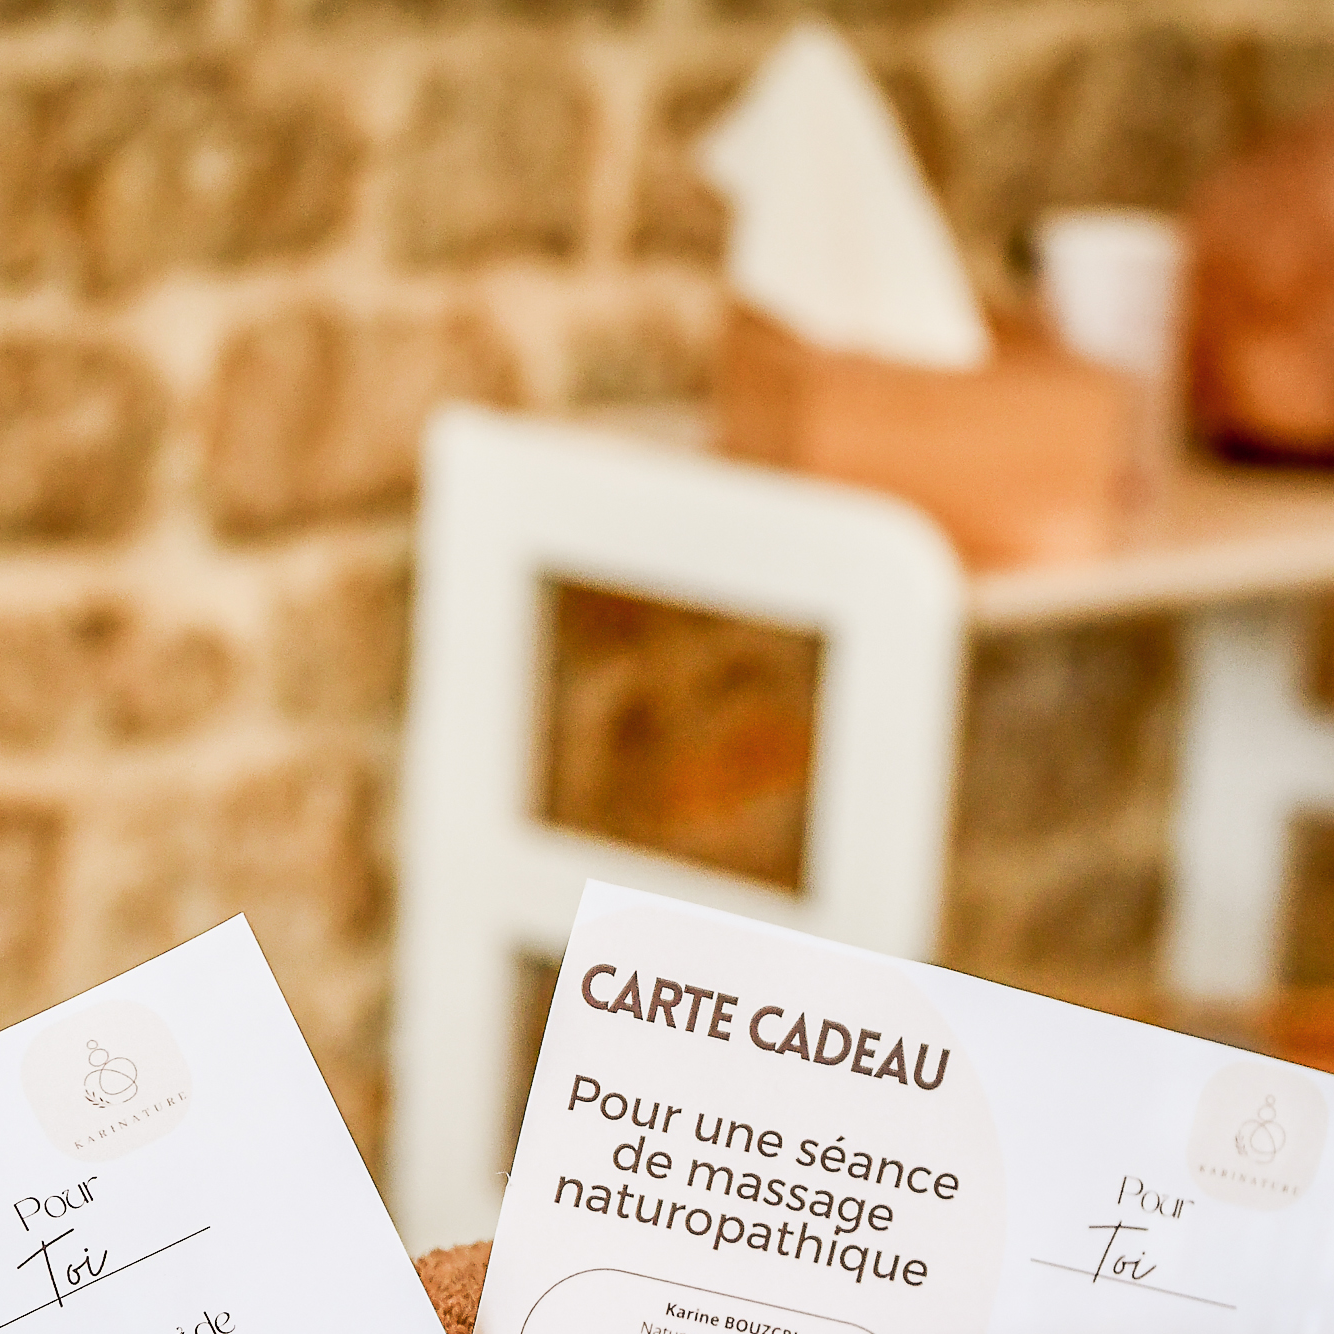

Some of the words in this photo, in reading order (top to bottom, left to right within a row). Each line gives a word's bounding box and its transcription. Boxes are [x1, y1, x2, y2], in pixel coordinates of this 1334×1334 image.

[581, 963, 739, 1041] CARTE
[749, 1005, 951, 1091] CADEAU
[74, 1091, 187, 1150] KARINATURE
[567, 1074, 682, 1134] Pour
[694, 1112, 783, 1159] une
[795, 1136, 960, 1200] séance
[13, 1176, 98, 1232] Pour
[612, 1135, 673, 1179] de
[686, 1159, 894, 1235] massage
[1118, 1175, 1195, 1219] Pour
[1199, 1163, 1299, 1196] KARINATURE
[554, 1175, 928, 1287] naturopathique
[1089, 1220, 1157, 1283] Toi
[17, 1228, 108, 1308] Toi
[666, 1302, 720, 1328] Karine
